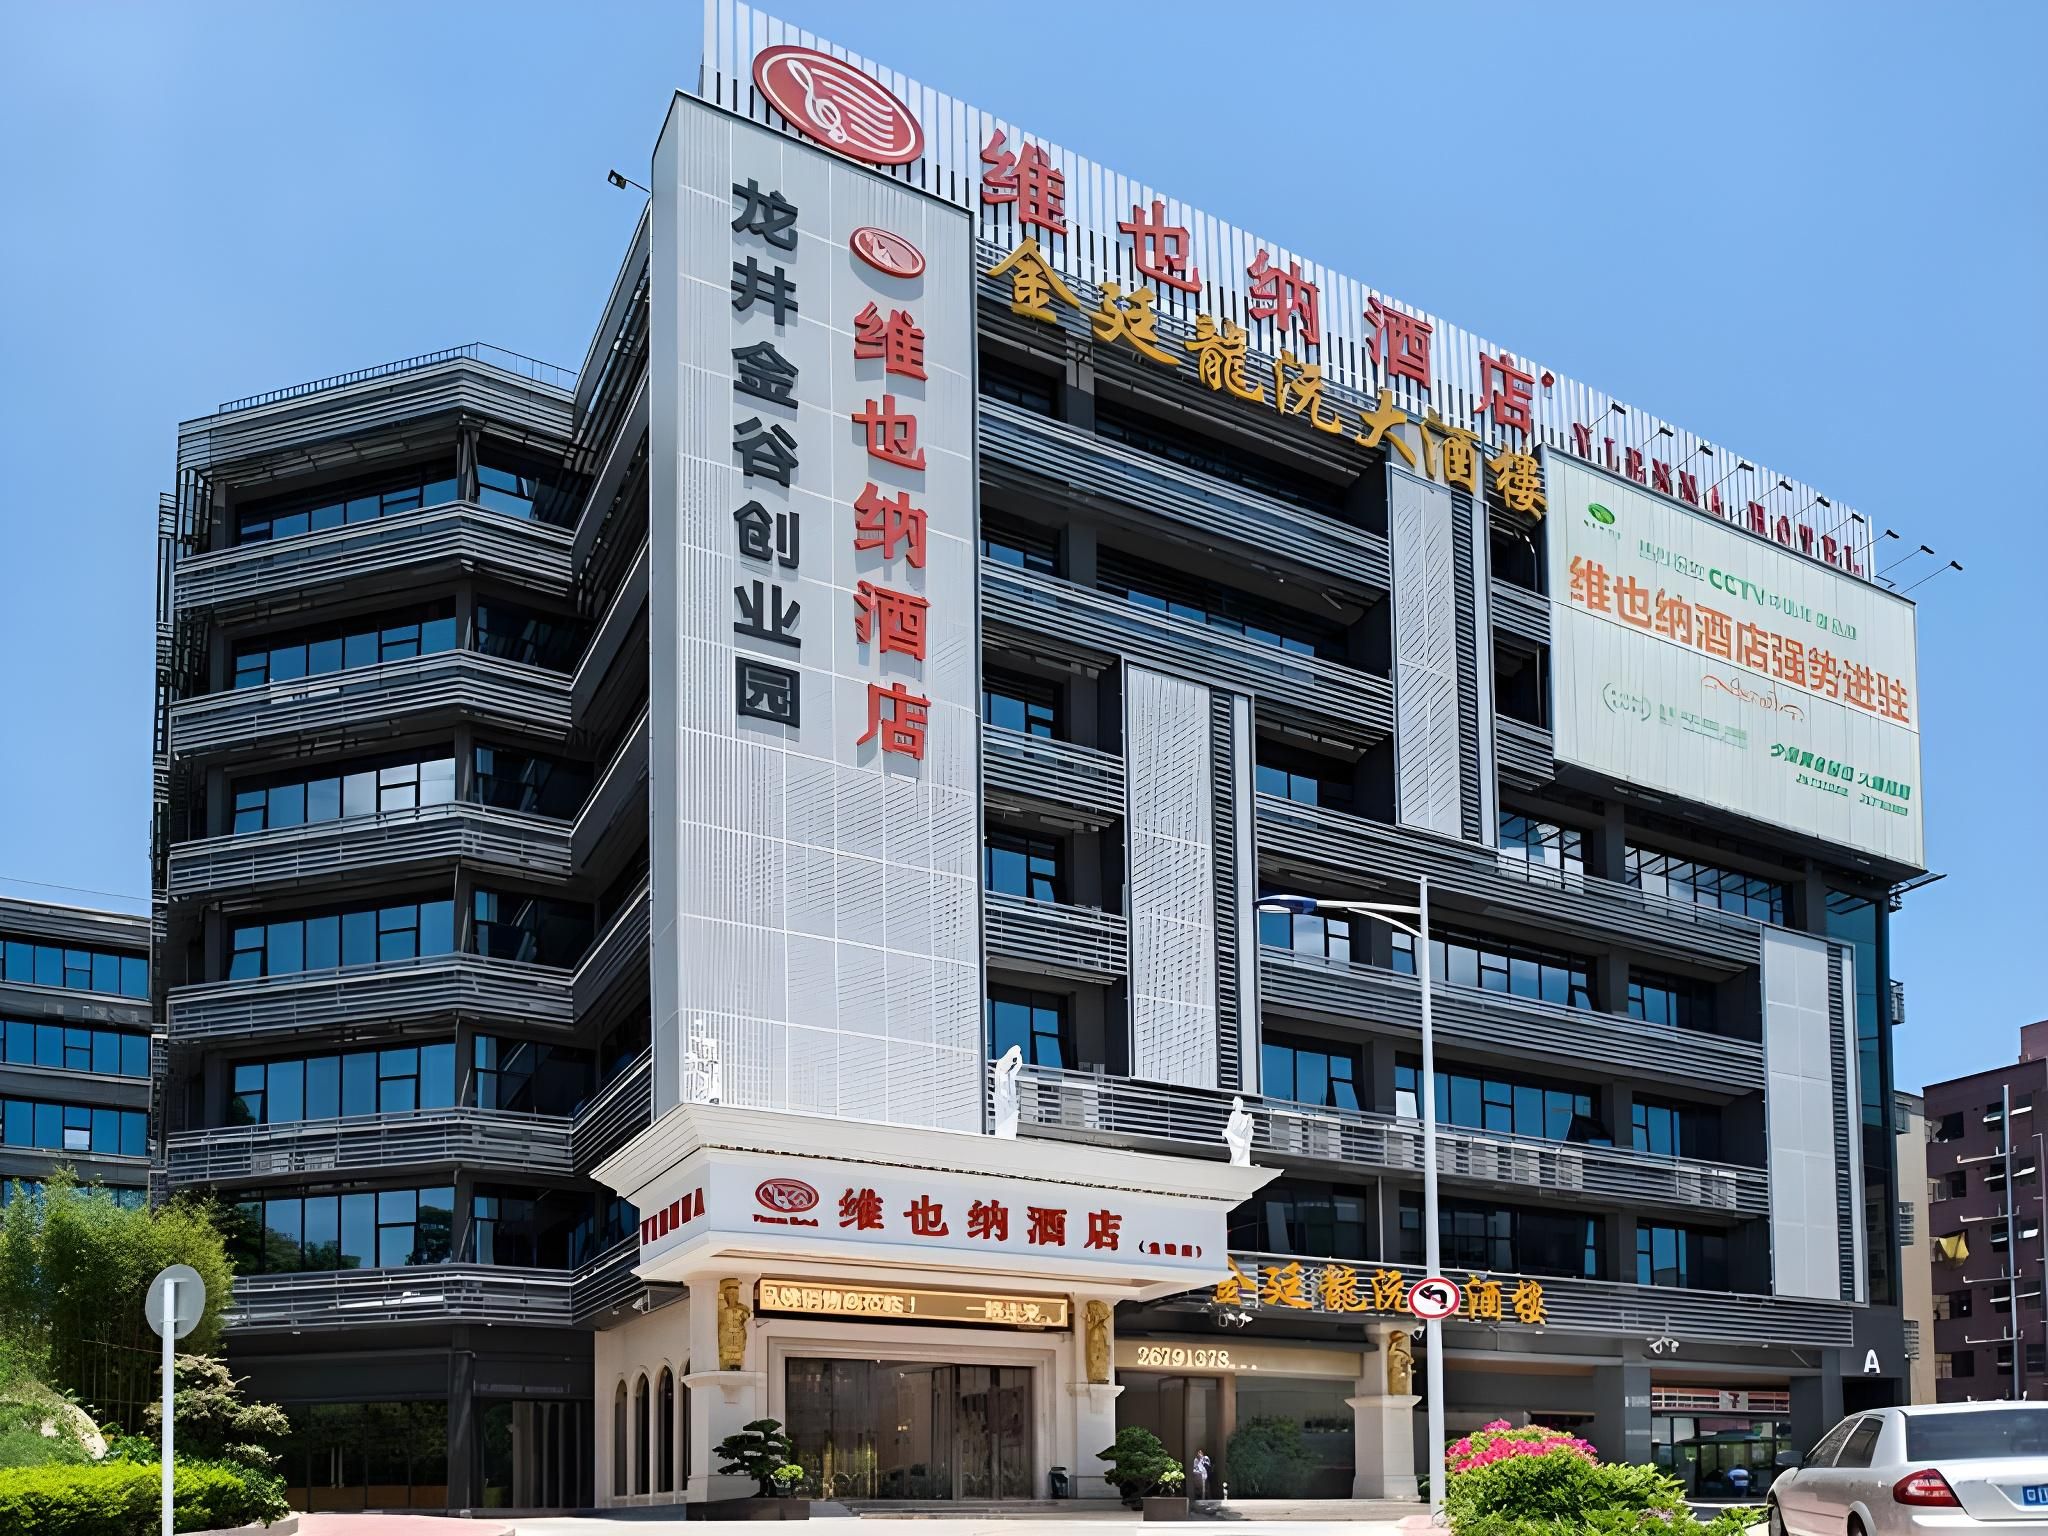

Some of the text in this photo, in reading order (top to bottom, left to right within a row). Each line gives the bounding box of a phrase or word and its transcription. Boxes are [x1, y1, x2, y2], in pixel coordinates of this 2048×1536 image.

[980, 128, 1534, 438] 维也纳酒店
[731, 177, 801, 729] 龙井金谷创业园
[851, 301, 931, 761] 维也纳酒店
[1569, 554, 1911, 725] 维也纳酒店强势进驻
[1708, 566, 1765, 606] CCTV
[838, 1187, 1123, 1251] 维也纳酒店
[1863, 1348, 1881, 1375] A
